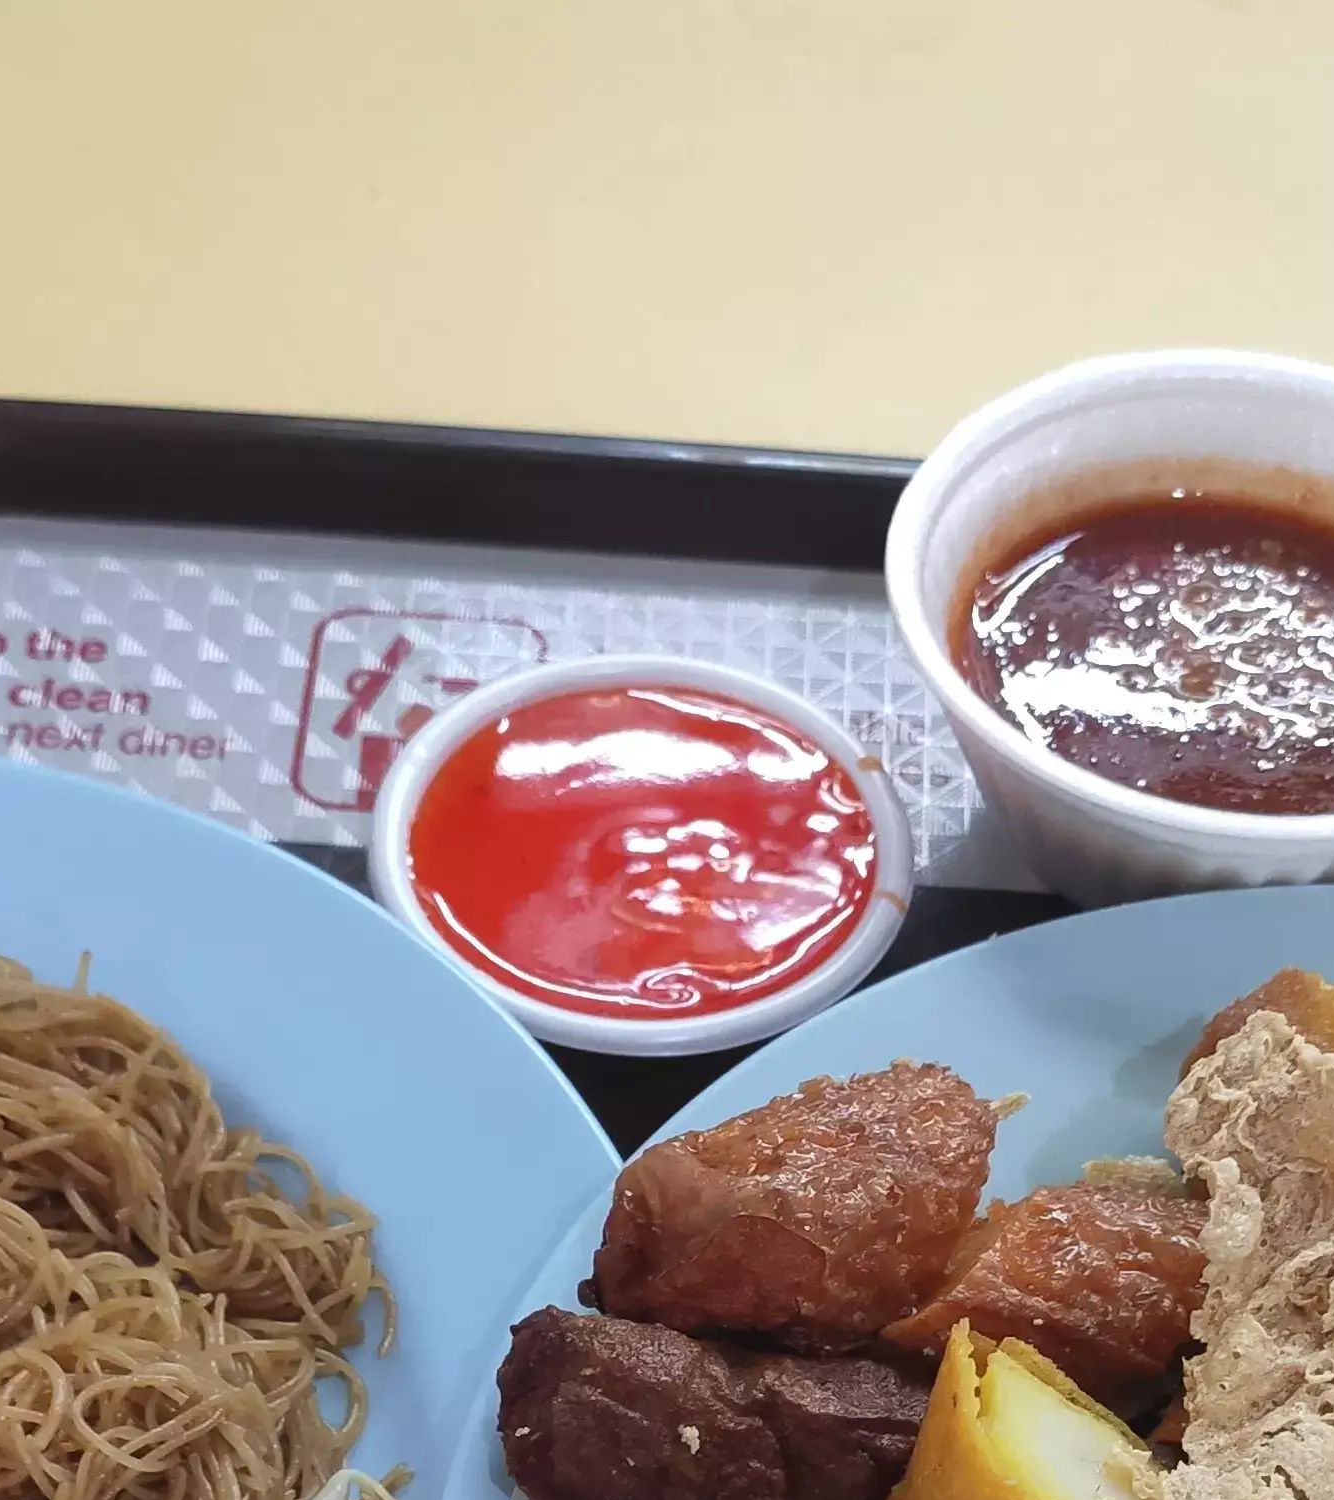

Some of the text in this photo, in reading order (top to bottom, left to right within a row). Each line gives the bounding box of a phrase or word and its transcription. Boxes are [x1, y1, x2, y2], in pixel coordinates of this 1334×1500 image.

[25, 626, 109, 662] the
[7, 676, 152, 716] clean
[7, 719, 105, 754] next
